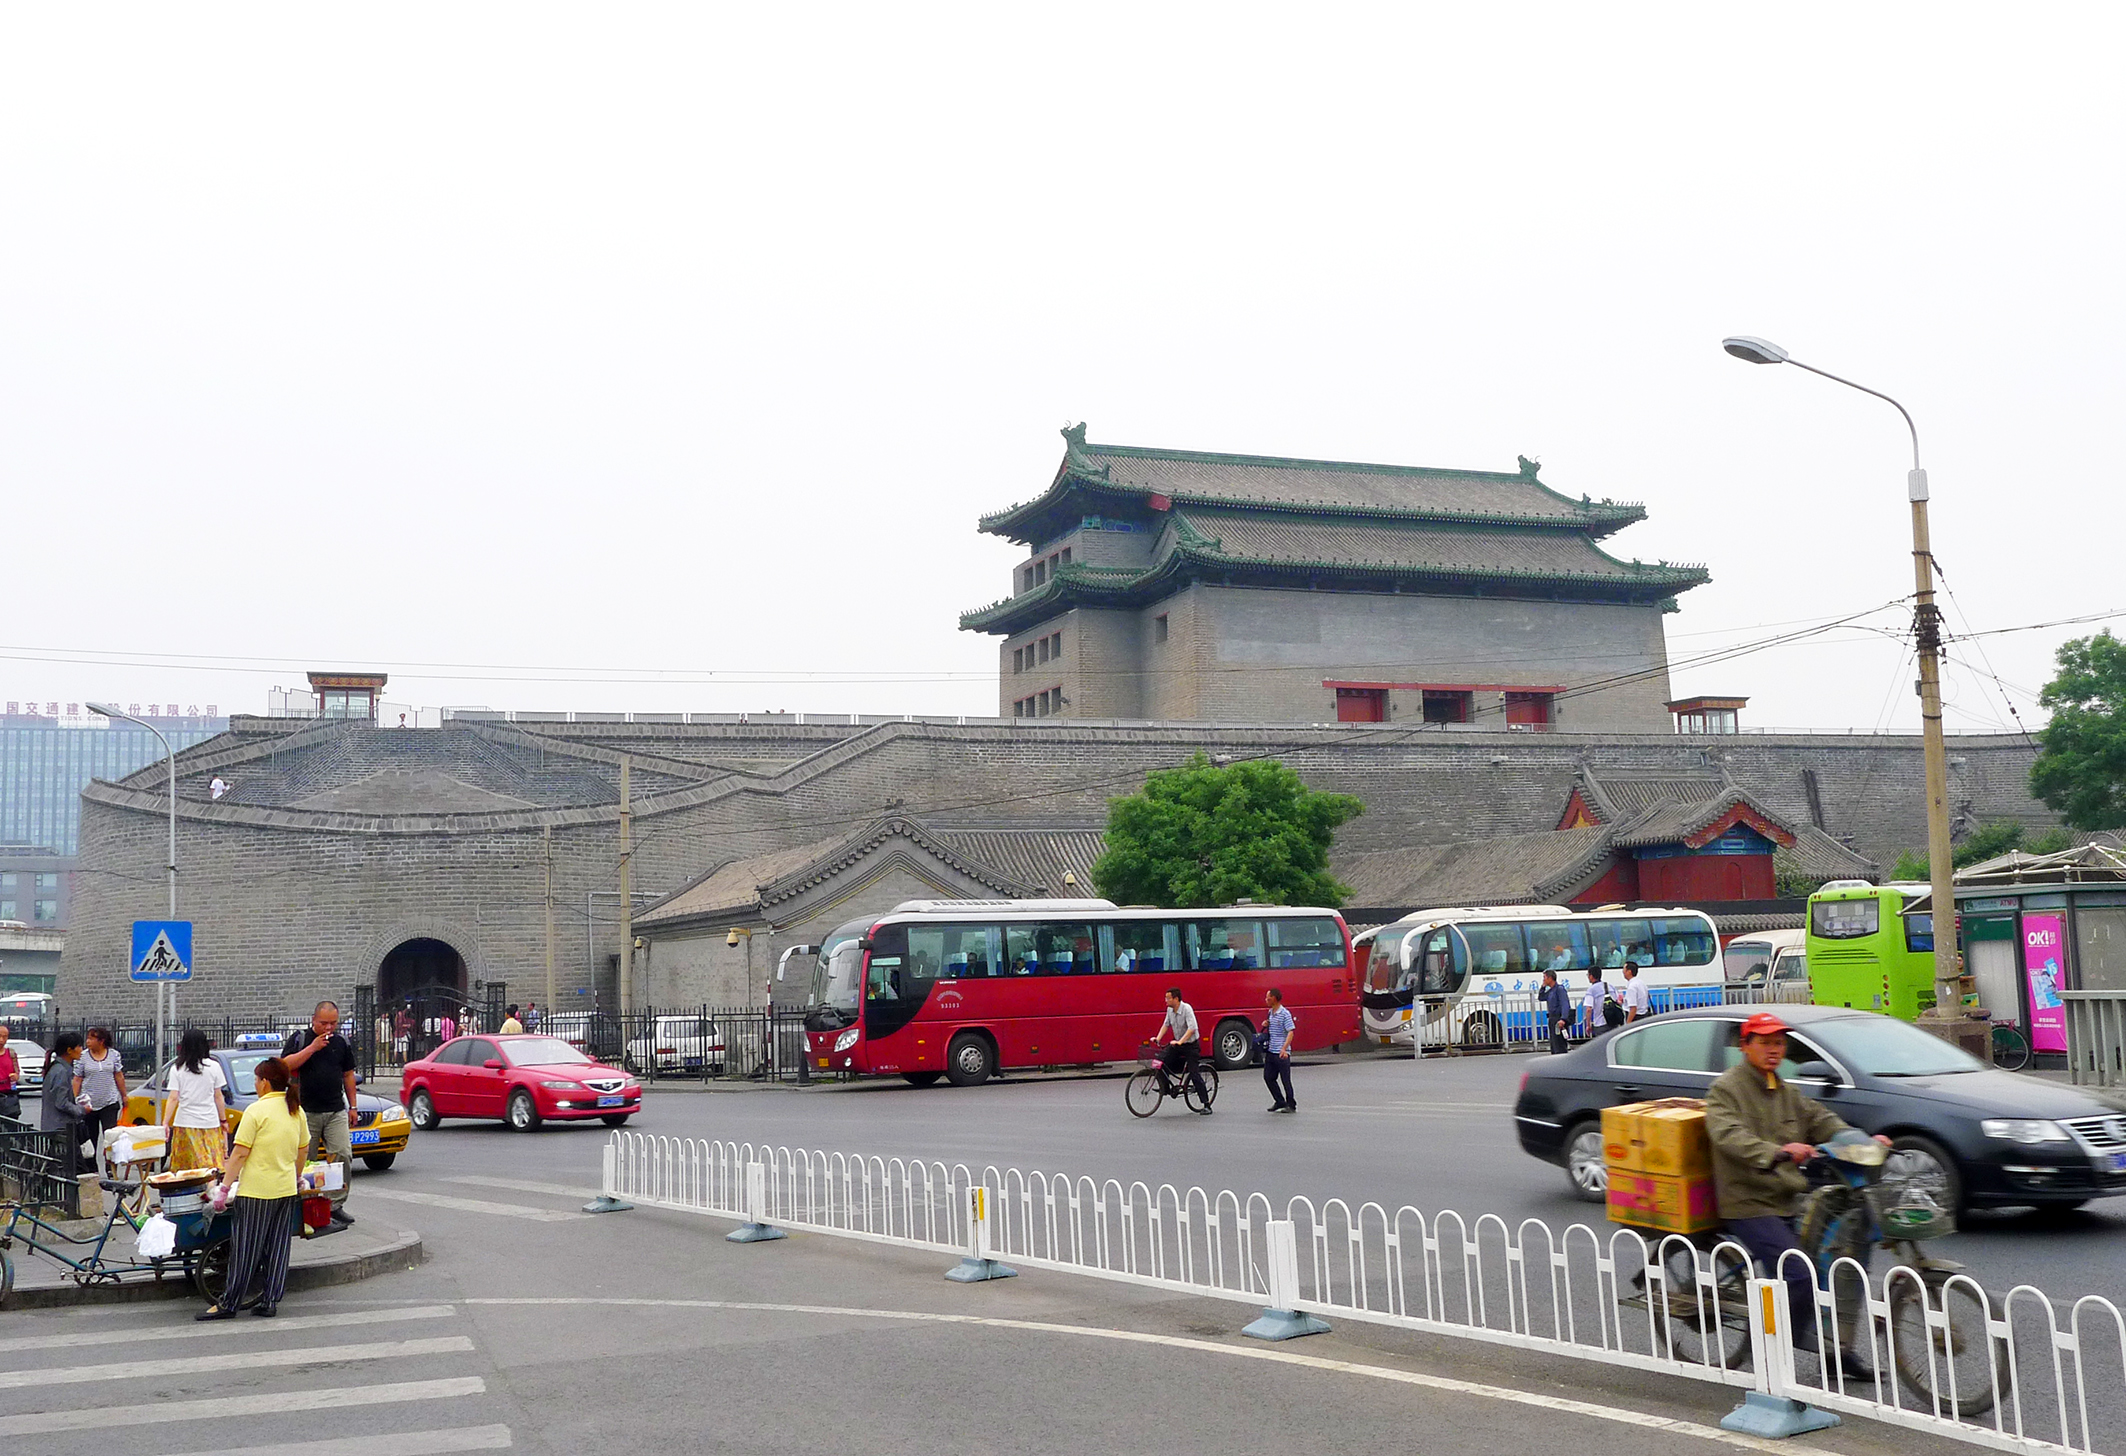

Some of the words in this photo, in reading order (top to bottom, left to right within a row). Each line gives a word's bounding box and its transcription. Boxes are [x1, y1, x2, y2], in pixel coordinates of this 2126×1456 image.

[6, 702, 218, 717] 国交通建份有限公司
[2028, 931, 2049, 946] OK!
